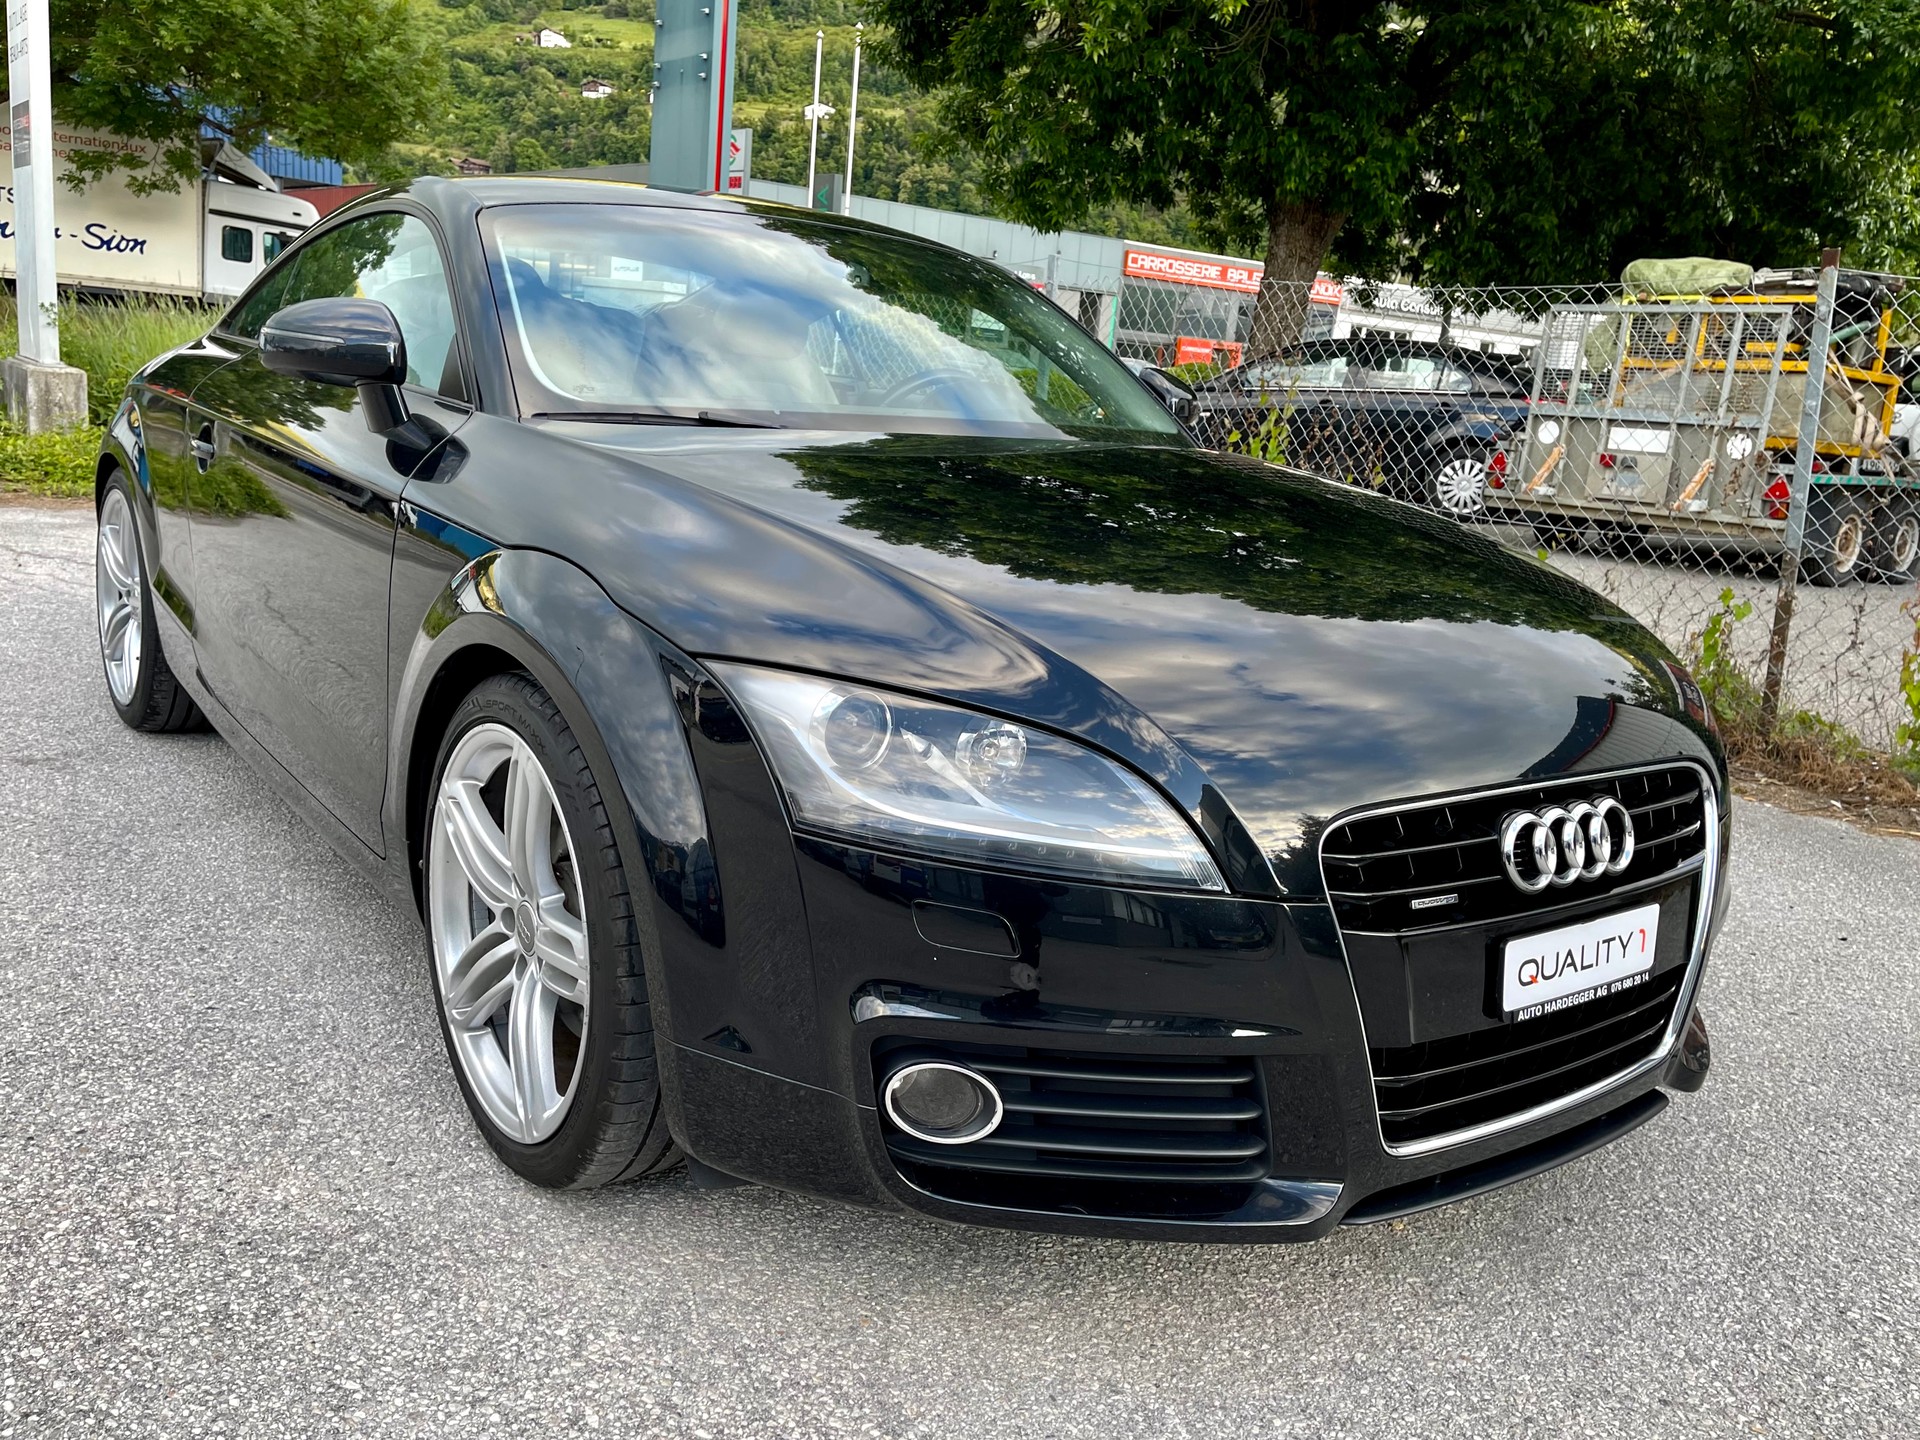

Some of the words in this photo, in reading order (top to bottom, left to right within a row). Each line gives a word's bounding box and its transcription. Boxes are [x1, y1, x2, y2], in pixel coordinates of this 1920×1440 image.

[53, 131, 148, 154] ternationaux
[81, 223, 147, 255] Sion
[1127, 252, 1222, 280] CARROSSERIE
[483, 699, 517, 717] SPORT
[1518, 931, 1634, 987] QUALITY
[1639, 928, 1646, 953] 1
[1517, 1005, 1543, 1022] AUTO
[1544, 990, 1595, 1014] HARDEGGER
[1596, 985, 1608, 998] AG
[1610, 980, 1622, 993] 076
[1622, 976, 1634, 990] 680
[1634, 974, 1642, 987] 20
[1642, 972, 1649, 982] 14
